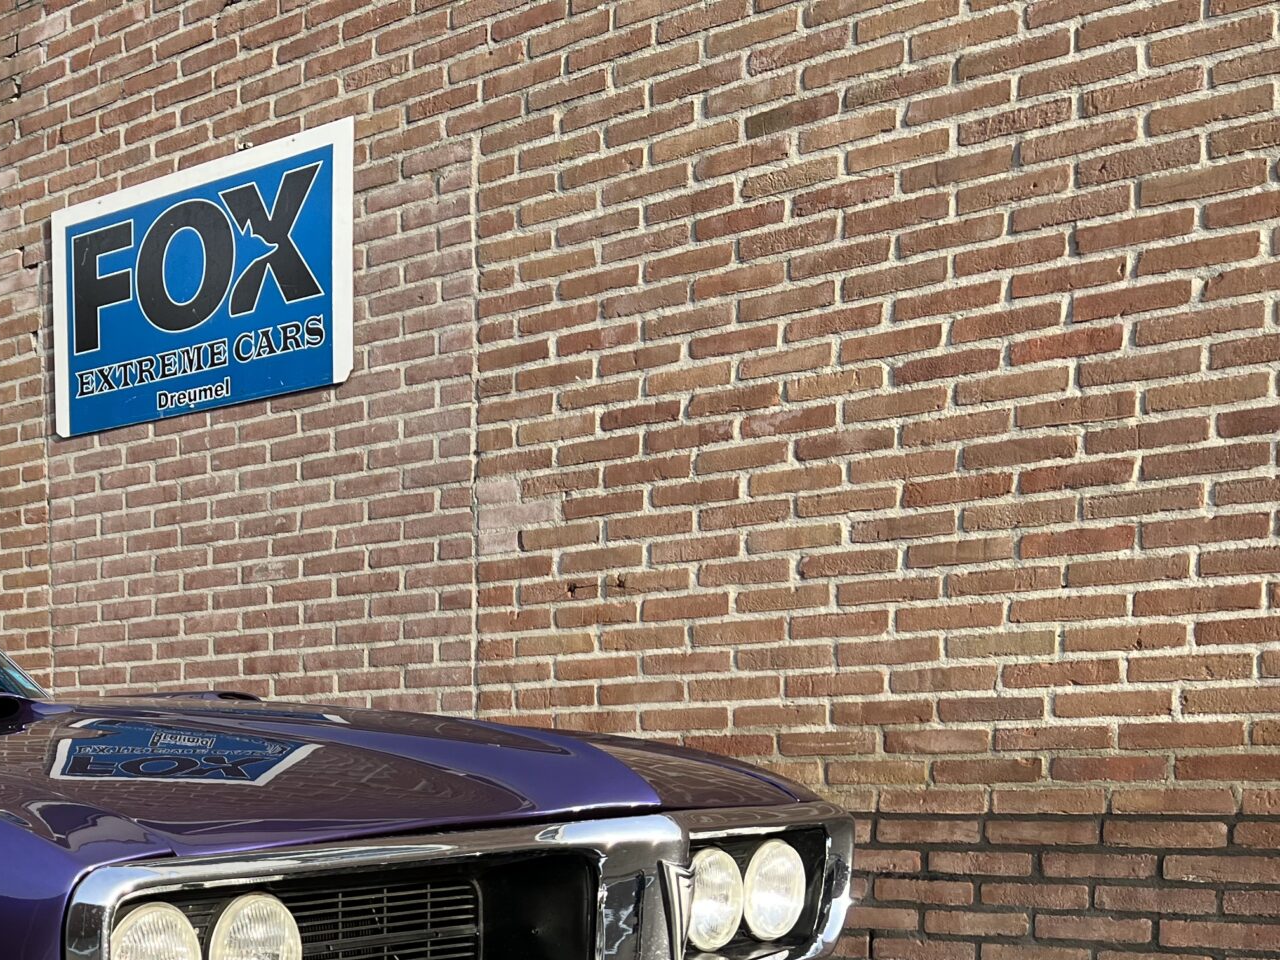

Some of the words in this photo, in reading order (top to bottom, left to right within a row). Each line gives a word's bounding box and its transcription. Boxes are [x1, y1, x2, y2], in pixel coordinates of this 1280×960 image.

[72, 160, 325, 356] FOX
[75, 338, 228, 399] EXTREME
[233, 314, 325, 364] CARS
[157, 377, 231, 410] Dreumel
